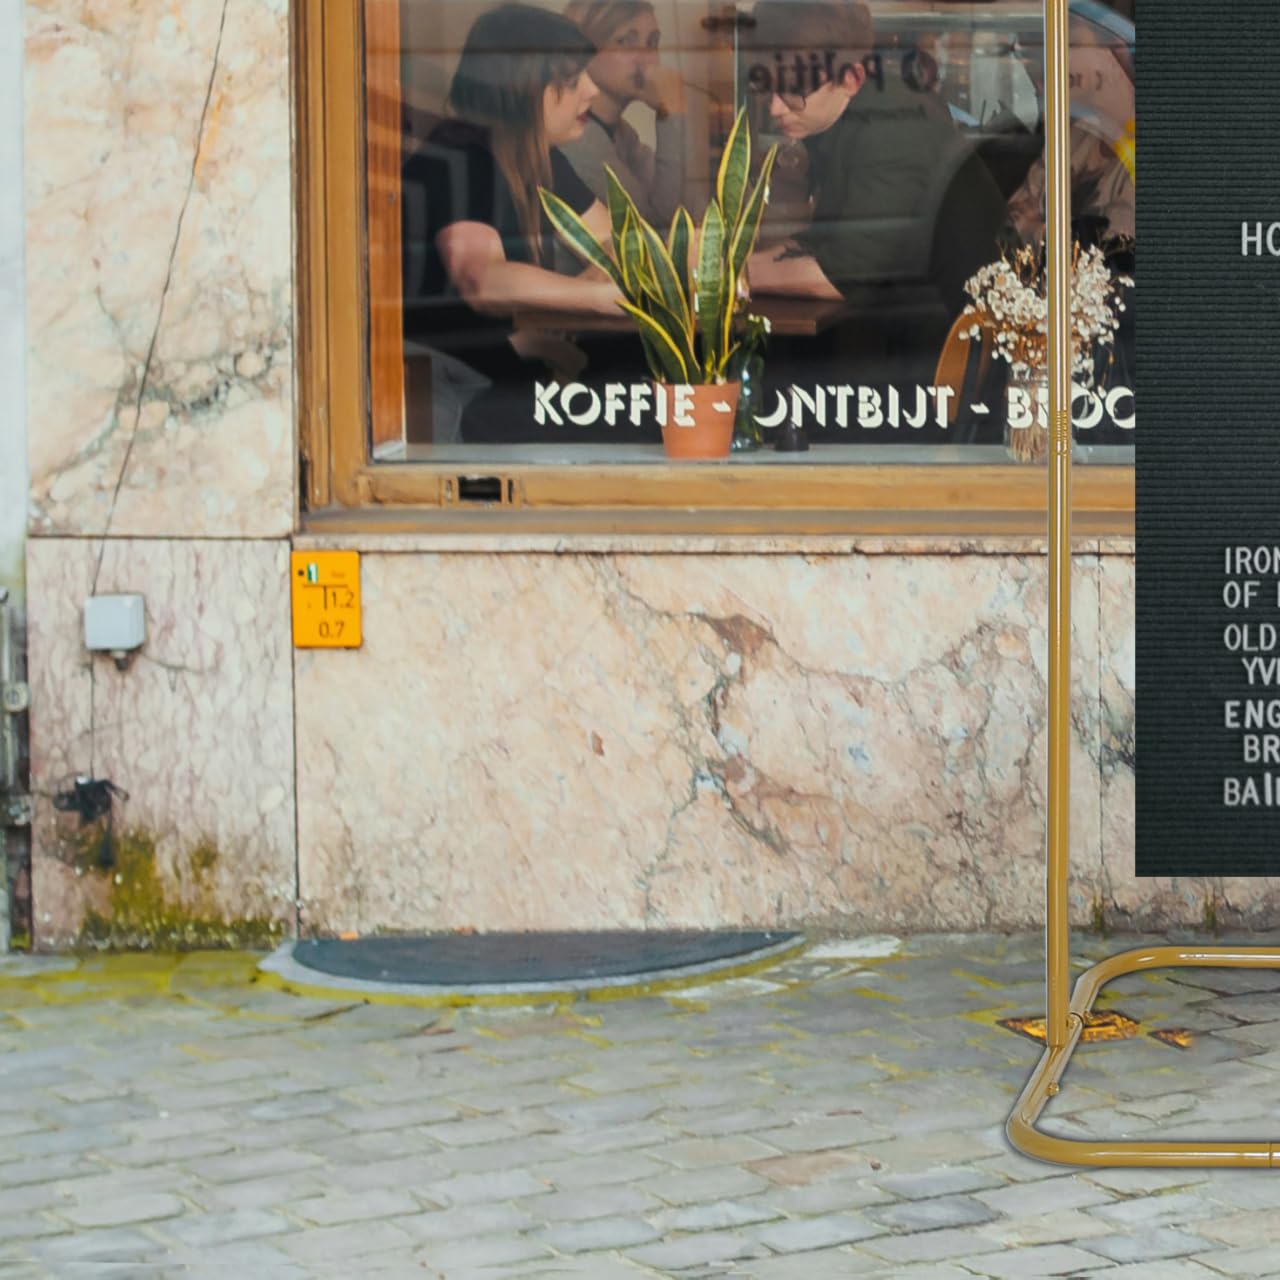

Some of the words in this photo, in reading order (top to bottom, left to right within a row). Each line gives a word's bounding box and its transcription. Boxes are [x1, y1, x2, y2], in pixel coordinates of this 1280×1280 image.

[533, 380, 696, 428] KOFFIE
[1223, 580, 1261, 610] OF
[1223, 622, 1277, 652] OLD
